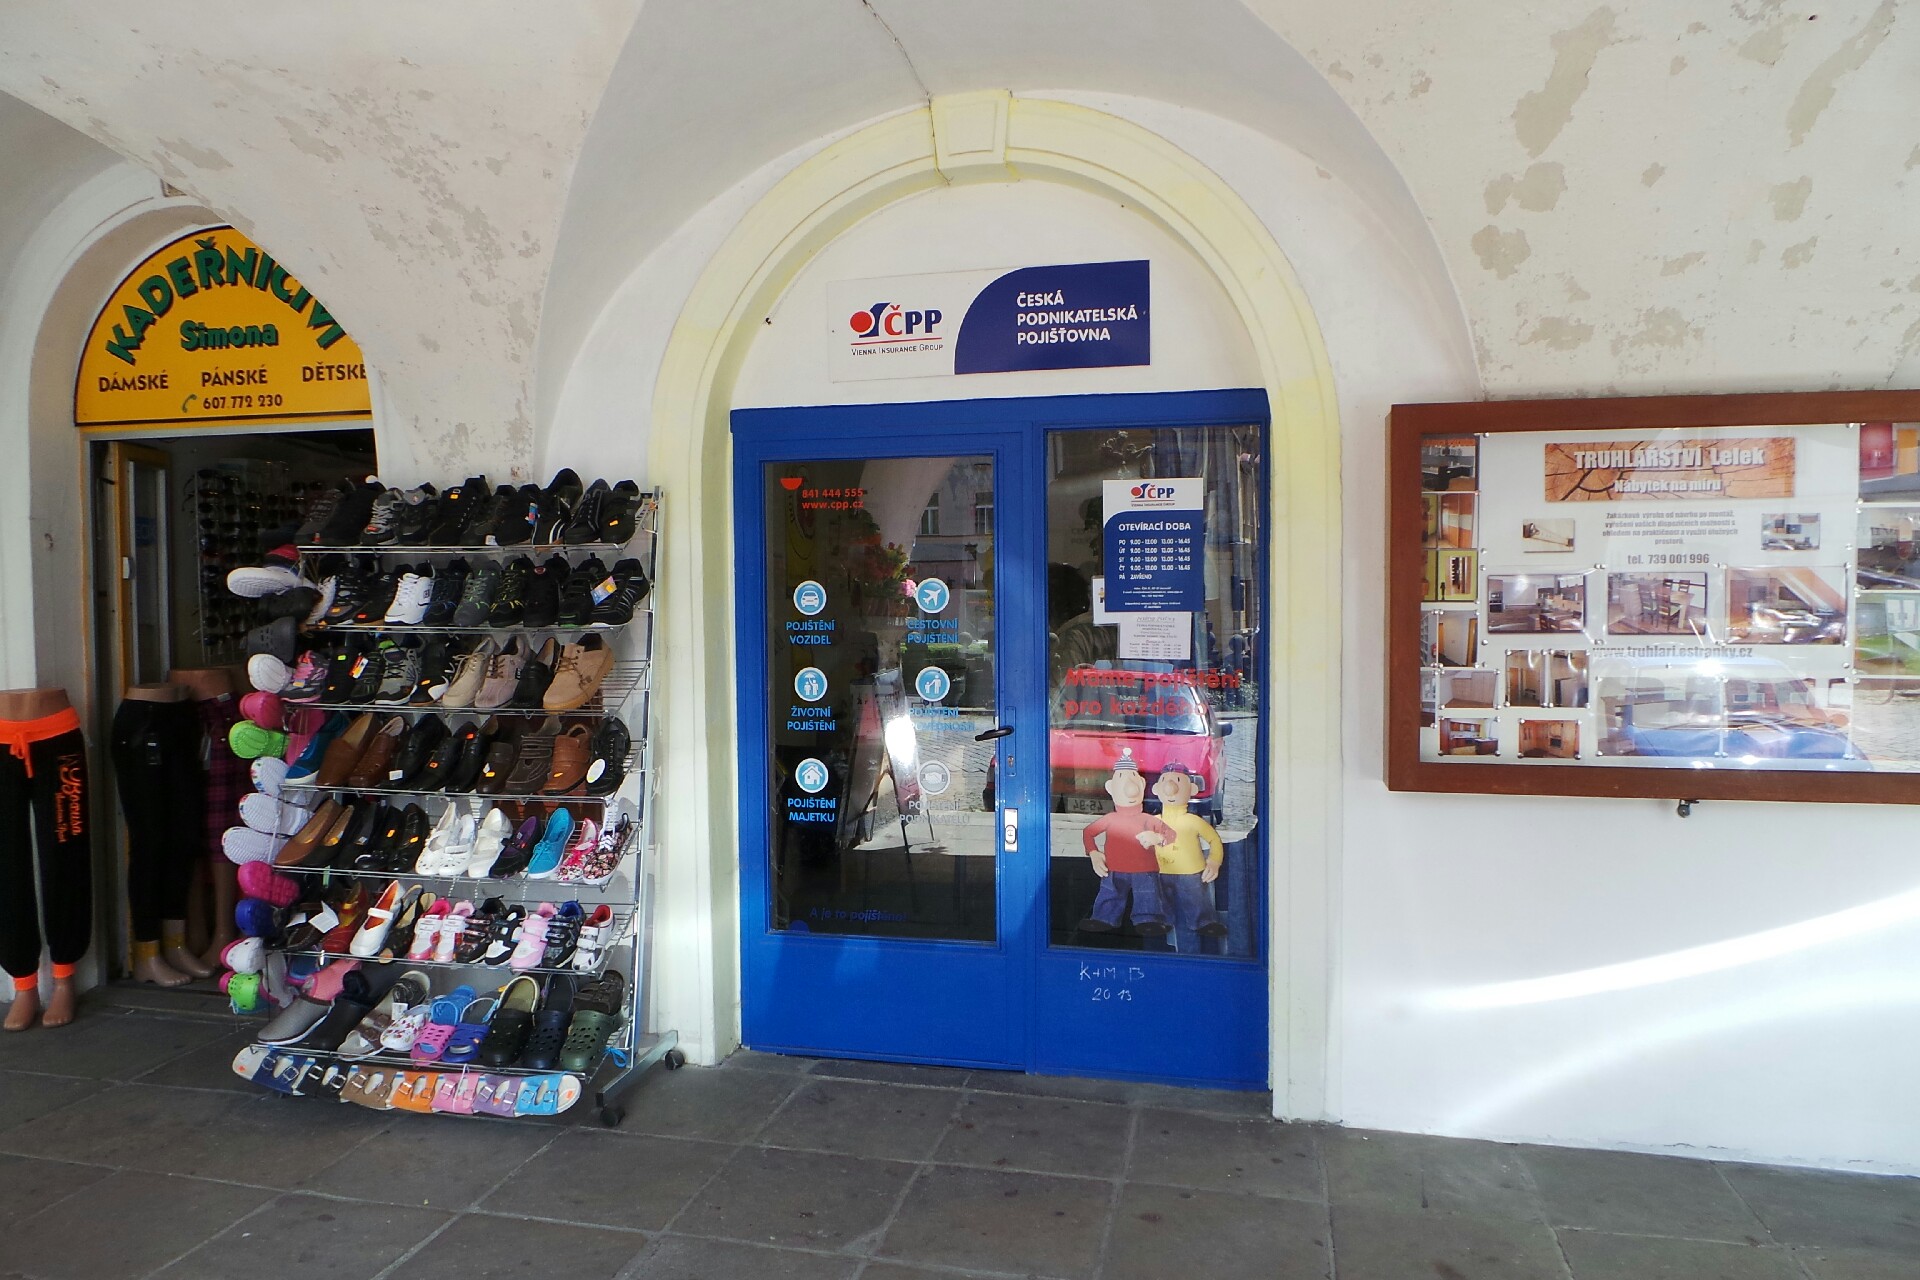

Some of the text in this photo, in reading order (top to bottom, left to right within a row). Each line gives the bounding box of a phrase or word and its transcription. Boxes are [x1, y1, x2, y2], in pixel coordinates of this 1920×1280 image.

[1016, 290, 1064, 308] ČESKÁ
[884, 304, 943, 336] ČPP
[1017, 304, 1138, 327] PODNIKATELSKÁ
[179, 320, 279, 352] Simona
[1017, 331, 1111, 346] POJIŠŤOVNA
[98, 371, 169, 392] DÁMSKÉ
[201, 365, 268, 388] PÁNSKÉ
[203, 394, 283, 410] 607 772 230
[1573, 446, 1765, 469] TRUHLÁŘSTVÍ Lelek
[802, 488, 864, 498] 841 444 555
[1147, 484, 1175, 499] ČPP
[1614, 479, 1721, 494] Nábytek na míru
[802, 501, 864, 511] www.cpp.cz
[1118, 521, 1191, 531] OTEVÍRACÍ DOBA
[1627, 553, 1710, 565] tel. 739 001 996
[786, 619, 835, 631] POJIŠTĚNÍ
[907, 618, 958, 630] CESTOVNÍ
[790, 635, 832, 645] VOZIDEL
[791, 707, 831, 718] ŽIVOTNÍ
[1065, 699, 1102, 719] pro
[787, 720, 836, 731] POJIŠTĚNÍ
[787, 797, 836, 809] POJIŠTĚNÍ
[789, 813, 835, 822] MAJETKU
